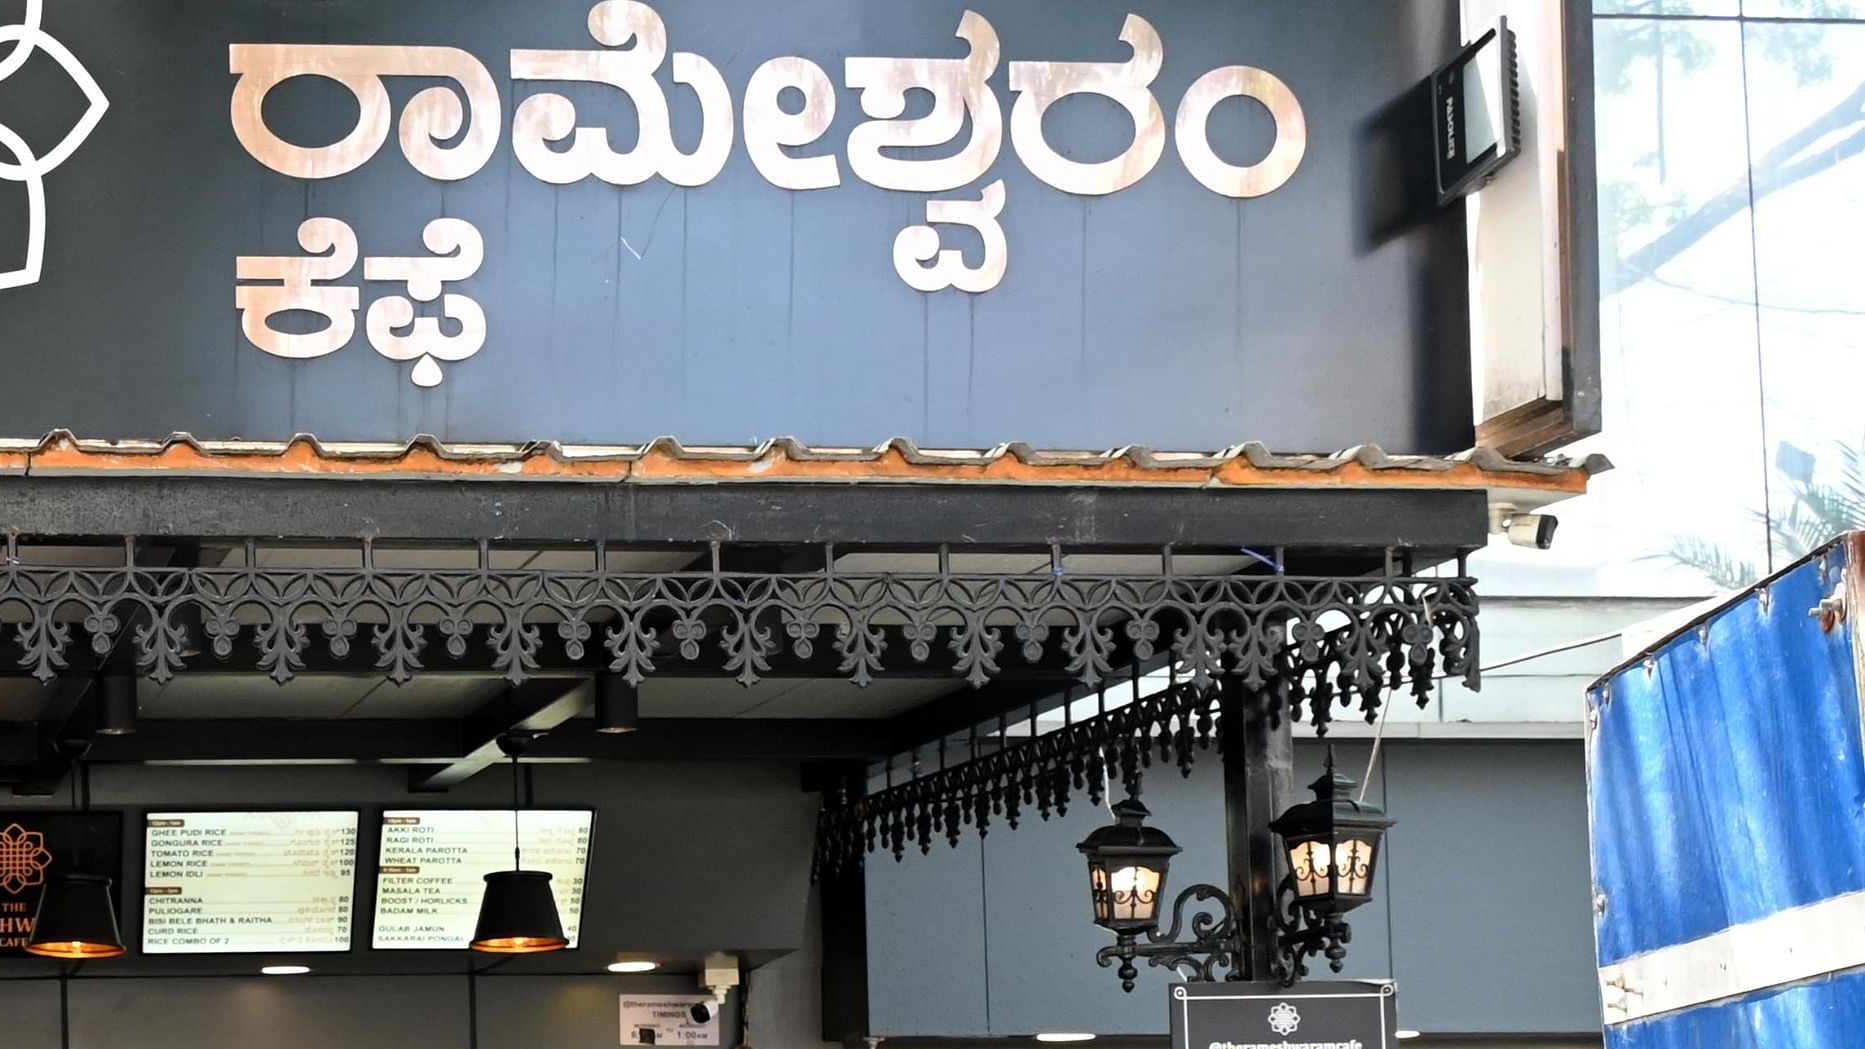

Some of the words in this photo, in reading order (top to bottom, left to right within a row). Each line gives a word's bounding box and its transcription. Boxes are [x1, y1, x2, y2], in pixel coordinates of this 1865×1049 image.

[229, 0, 1308, 294] ರಾಮೇಶ್ವರಂ
[234, 216, 488, 388] ಕೆಫೆ
[151, 839, 199, 847] GONGURA
[201, 839, 223, 847] RICE
[385, 857, 417, 865] WHEAT
[420, 857, 462, 865] PAROTTA
[149, 897, 203, 905] CHITRANNA
[1, 902, 27, 913] THE
[149, 907, 203, 915] PULIOGARE
